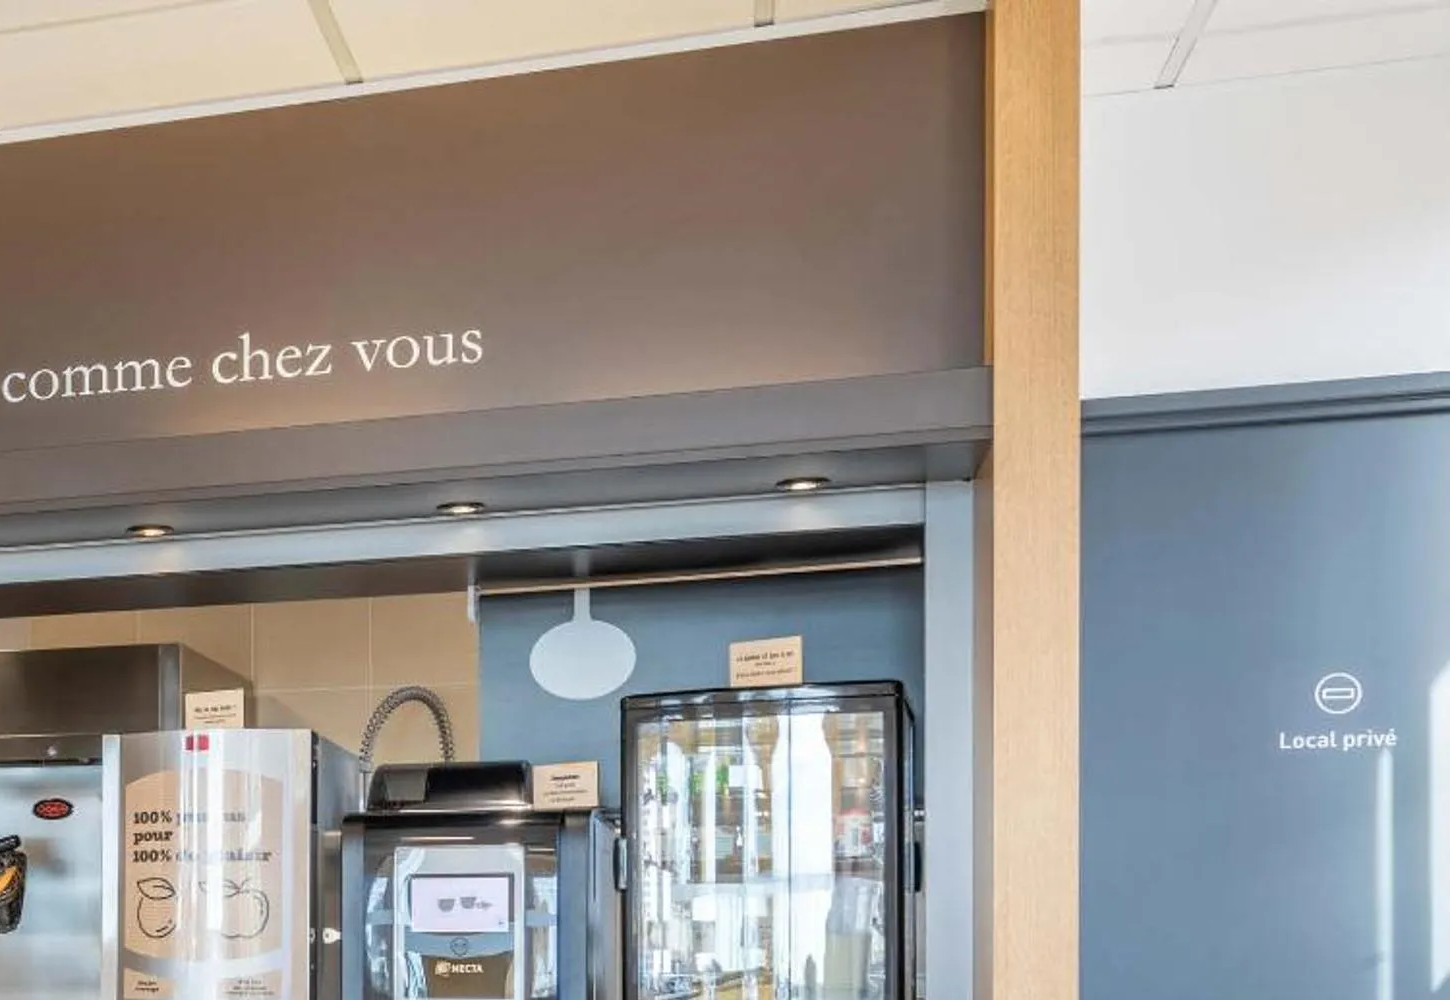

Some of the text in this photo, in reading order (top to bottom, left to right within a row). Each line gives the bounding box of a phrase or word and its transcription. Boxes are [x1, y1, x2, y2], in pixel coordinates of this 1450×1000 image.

[3, 357, 191, 402] comme
[212, 333, 331, 383] chez
[351, 330, 482, 371] vous
[1279, 728, 1398, 752] Local privé
[133, 811, 173, 824] 100%
[133, 829, 174, 846] pour
[132, 849, 172, 863] 100%
